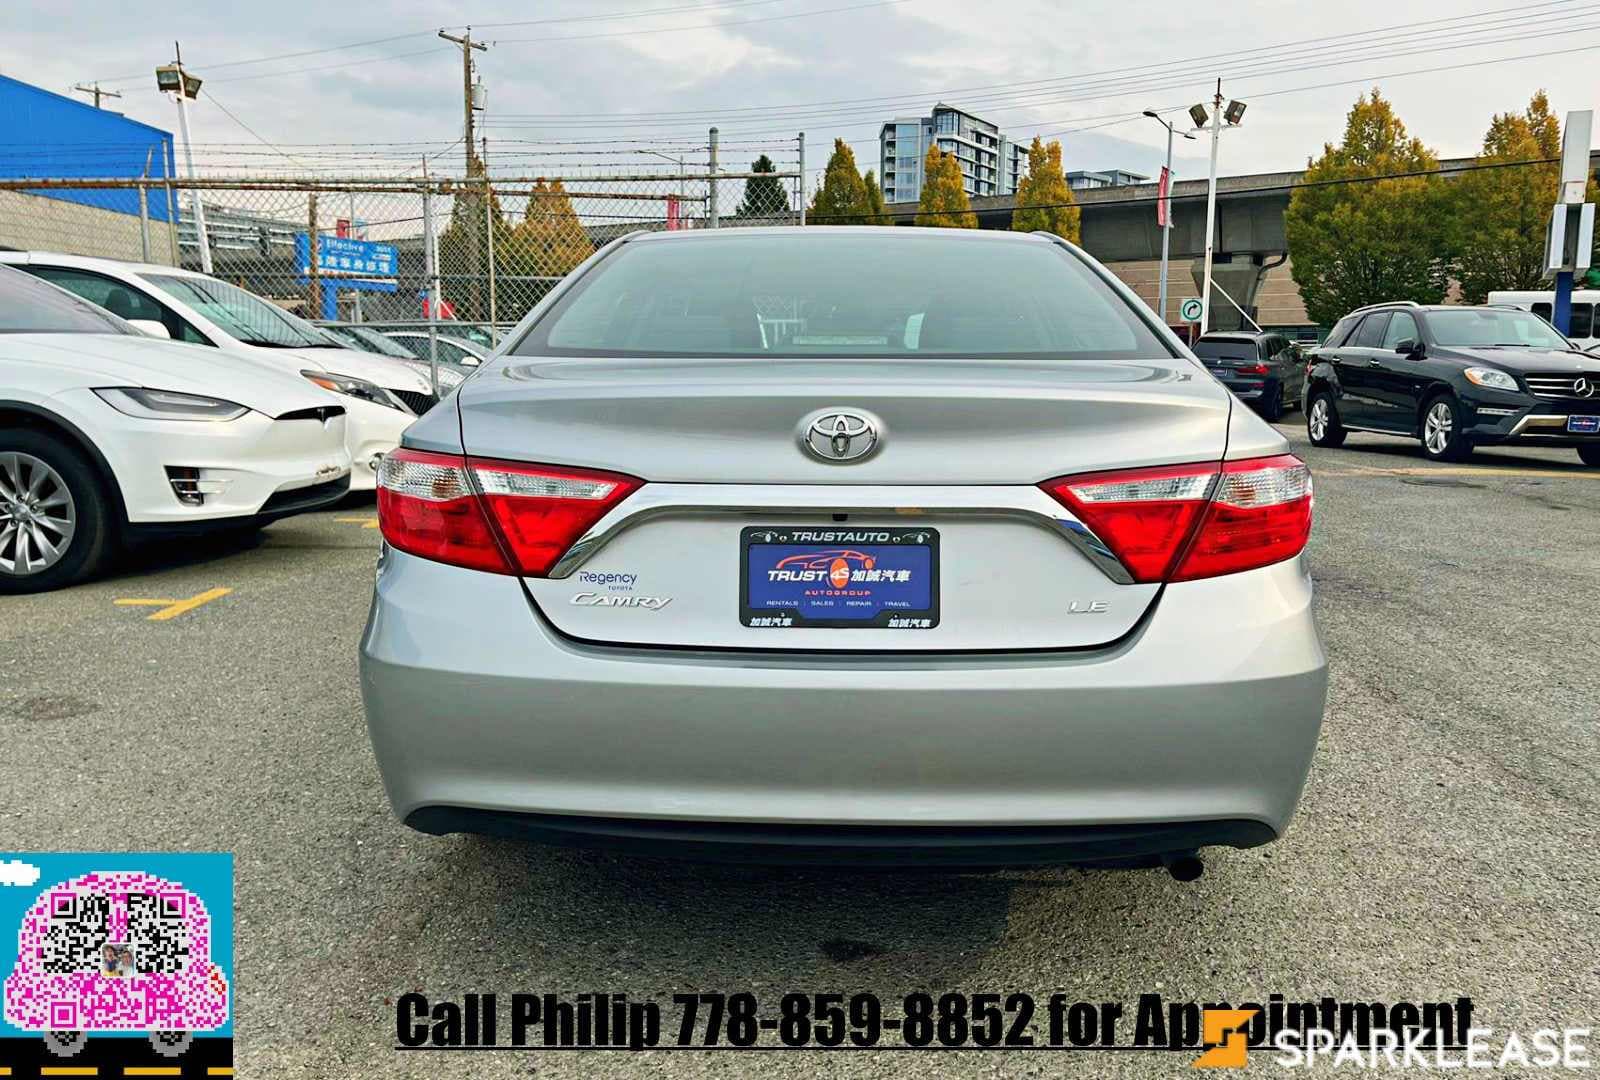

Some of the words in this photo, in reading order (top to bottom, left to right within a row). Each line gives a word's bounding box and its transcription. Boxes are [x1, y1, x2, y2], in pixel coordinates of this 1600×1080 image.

[792, 531, 889, 542] TRUSTAUTO
[580, 571, 637, 584] Regency
[768, 570, 828, 582] TRUST
[1067, 601, 1108, 614] LE
